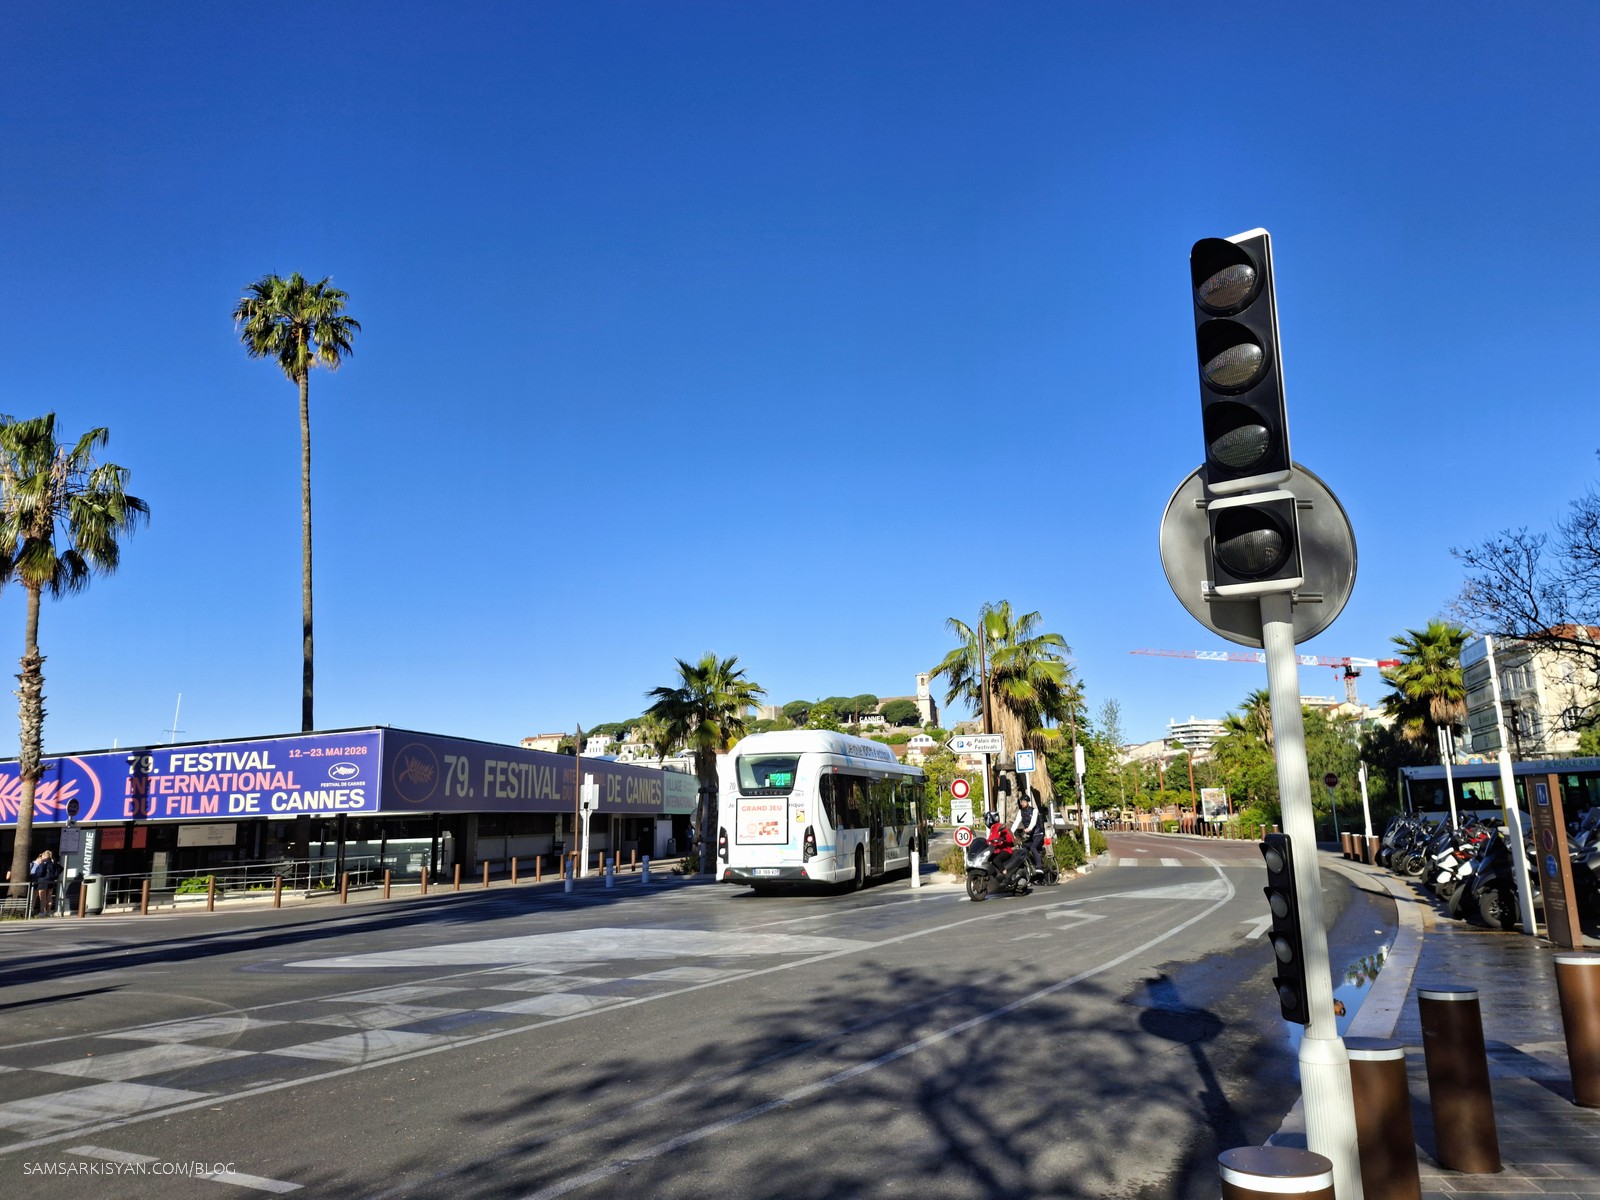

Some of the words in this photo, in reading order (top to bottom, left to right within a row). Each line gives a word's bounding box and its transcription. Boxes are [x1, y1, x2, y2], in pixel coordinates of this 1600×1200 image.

[859, 715, 885, 723] CANNES
[127, 755, 159, 775] 79.
[169, 751, 276, 773] FESTIVAL
[325, 747, 342, 757] MAI
[344, 746, 367, 755] 2026
[125, 771, 301, 796] INTERNATIONAL
[444, 755, 474, 798] 79.
[483, 759, 560, 800] FESTIVAL
[607, 774, 620, 803] DE
[626, 775, 661, 805] CANNES
[775, 773, 785, 786] 21
[123, 797, 157, 817] DU
[166, 794, 219, 816] FILM
[228, 793, 260, 813] DE
[271, 788, 365, 811] CANNES
[958, 832, 969, 841] 30
[83, 831, 94, 879] MARITIME
